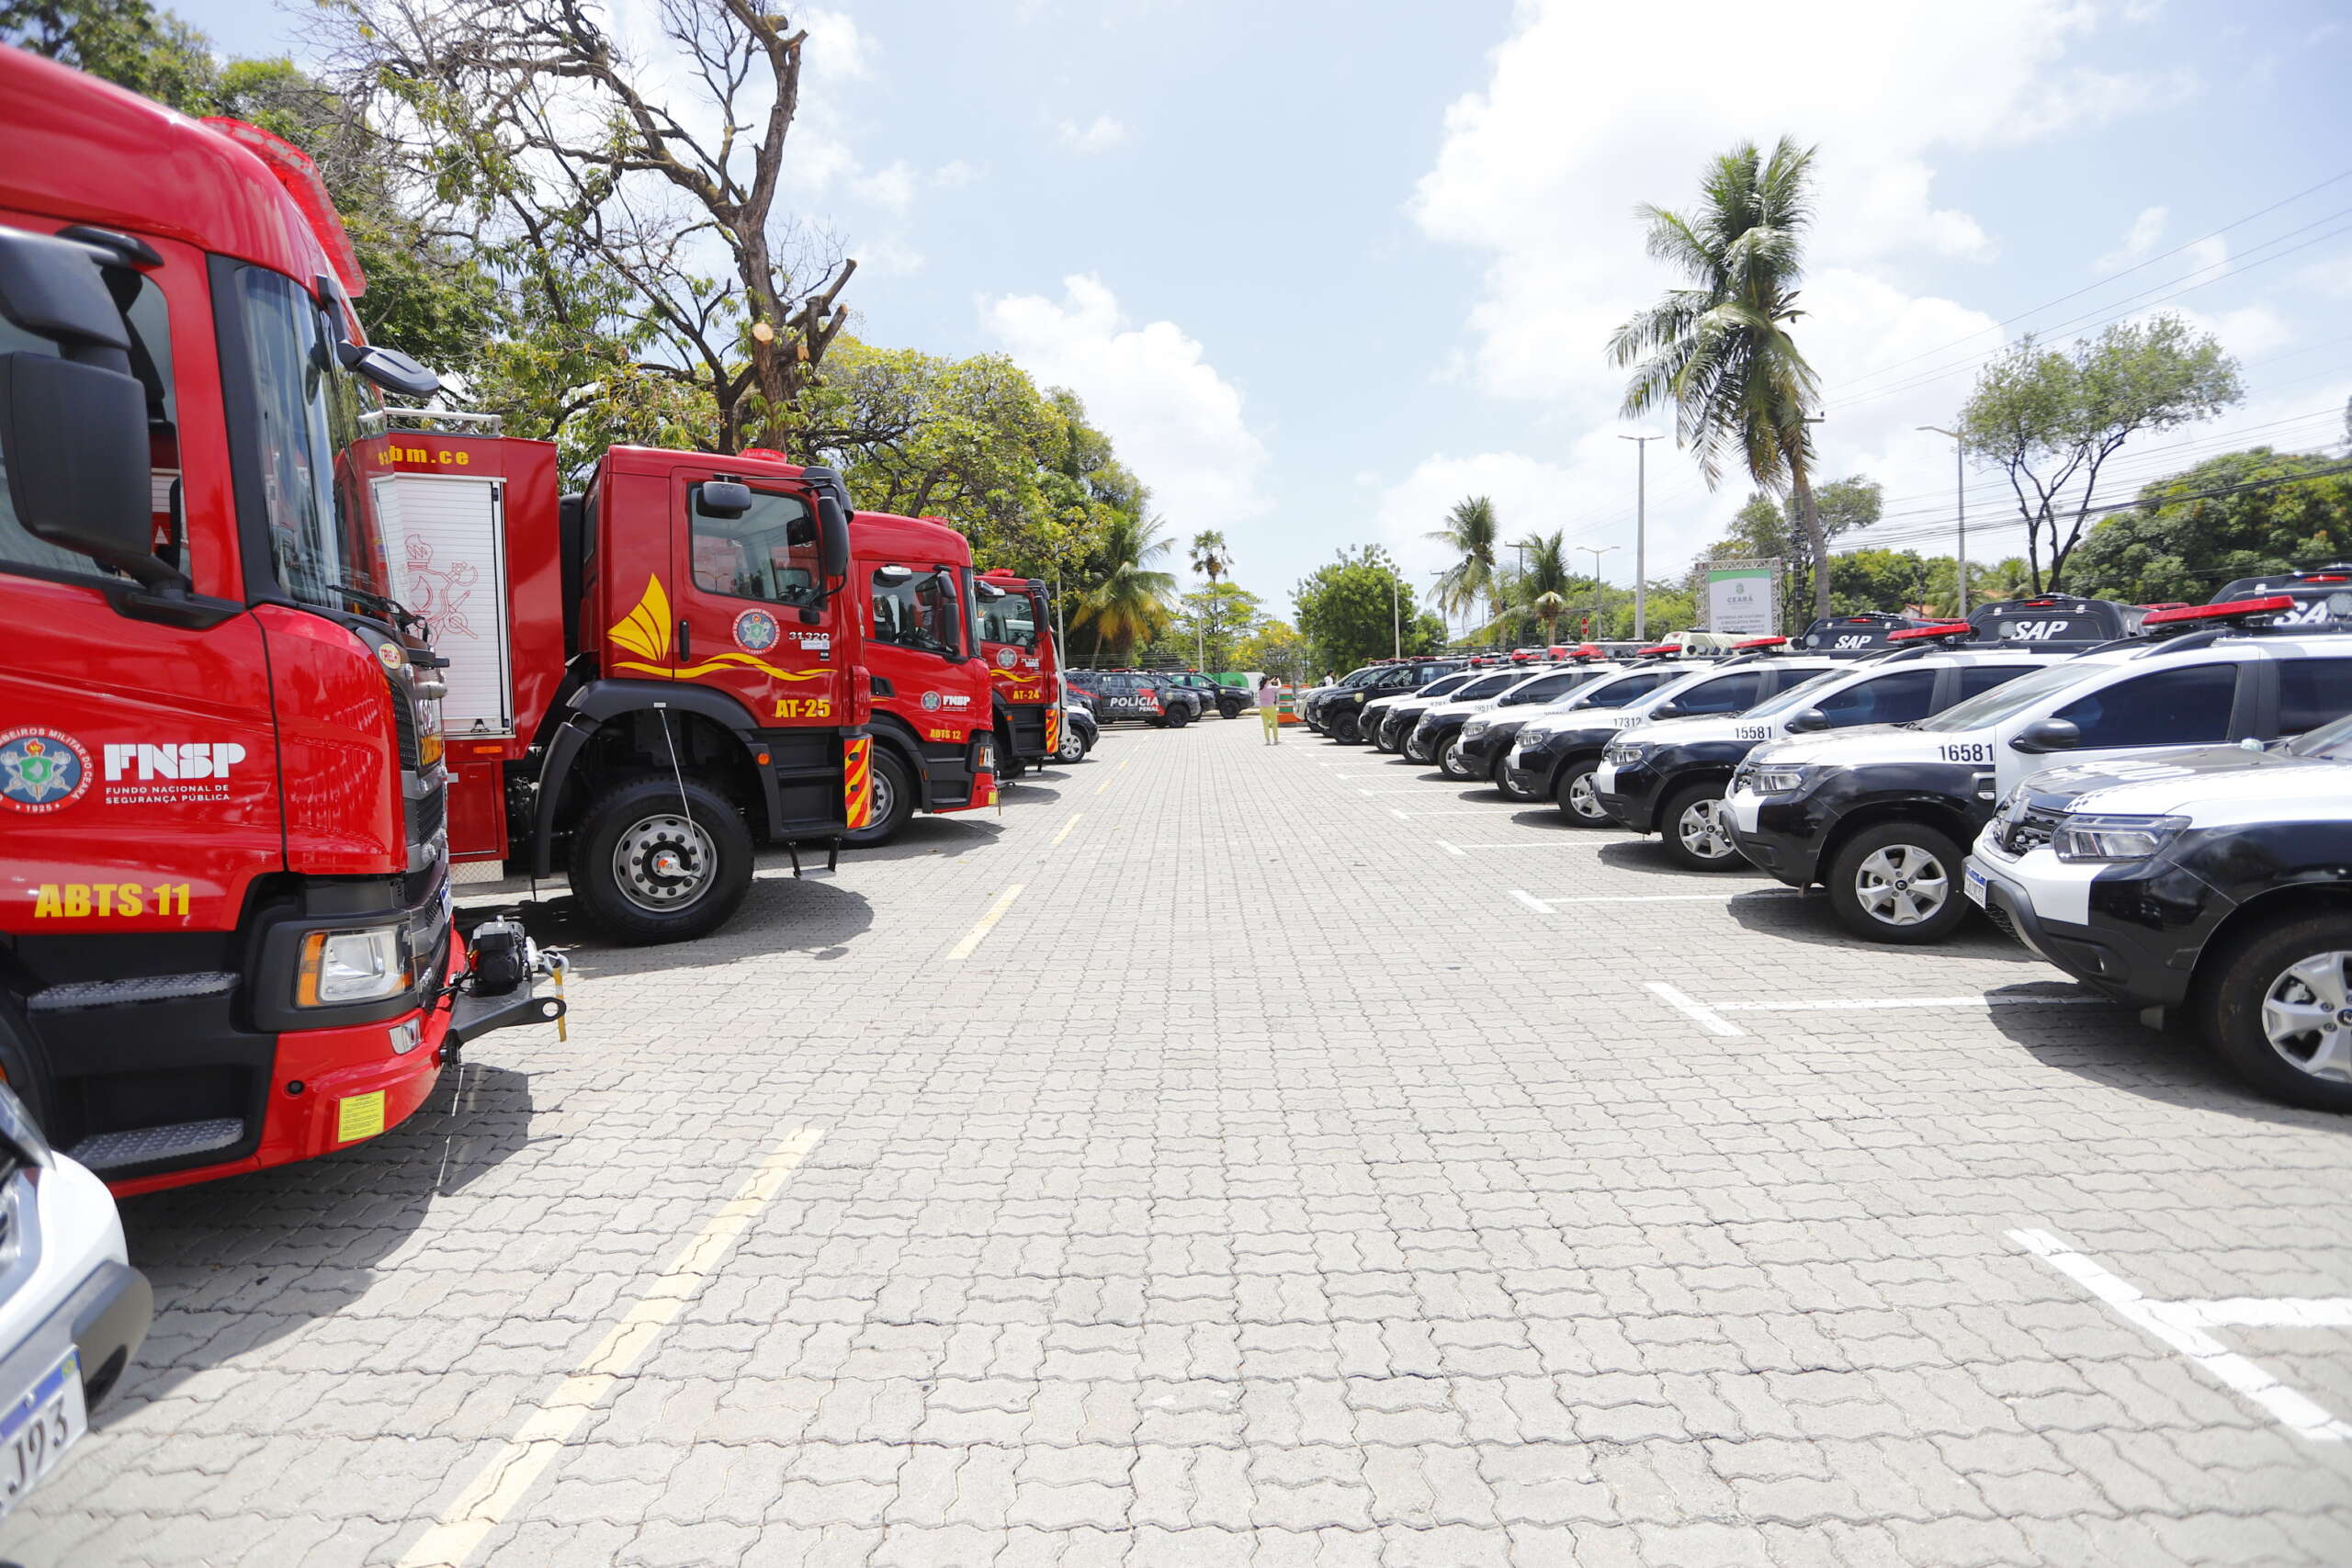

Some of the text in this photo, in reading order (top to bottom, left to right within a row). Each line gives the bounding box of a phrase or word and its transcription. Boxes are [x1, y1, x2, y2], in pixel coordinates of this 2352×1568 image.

[2011, 620, 2069, 640] SAP
[1835, 635, 1872, 649] SAP
[1013, 690, 1040, 700] AT-24
[1110, 694, 1159, 707] POLÍCIA
[775, 699, 831, 717] AT-25
[1613, 716, 1642, 728] 17312
[952, 730, 961, 739] 12
[1735, 726, 1772, 739] 15581
[0, 728, 45, 746] BEIROS
[49, 728, 86, 756] MILITAR
[1938, 743, 1994, 761] 16581
[104, 742, 246, 781] FNSP
[106, 784, 229, 795] FUNDO NACIONAL DE
[106, 793, 231, 805] SEGURANÇA PÚBLICA
[34, 883, 190, 918] ABTS 11
